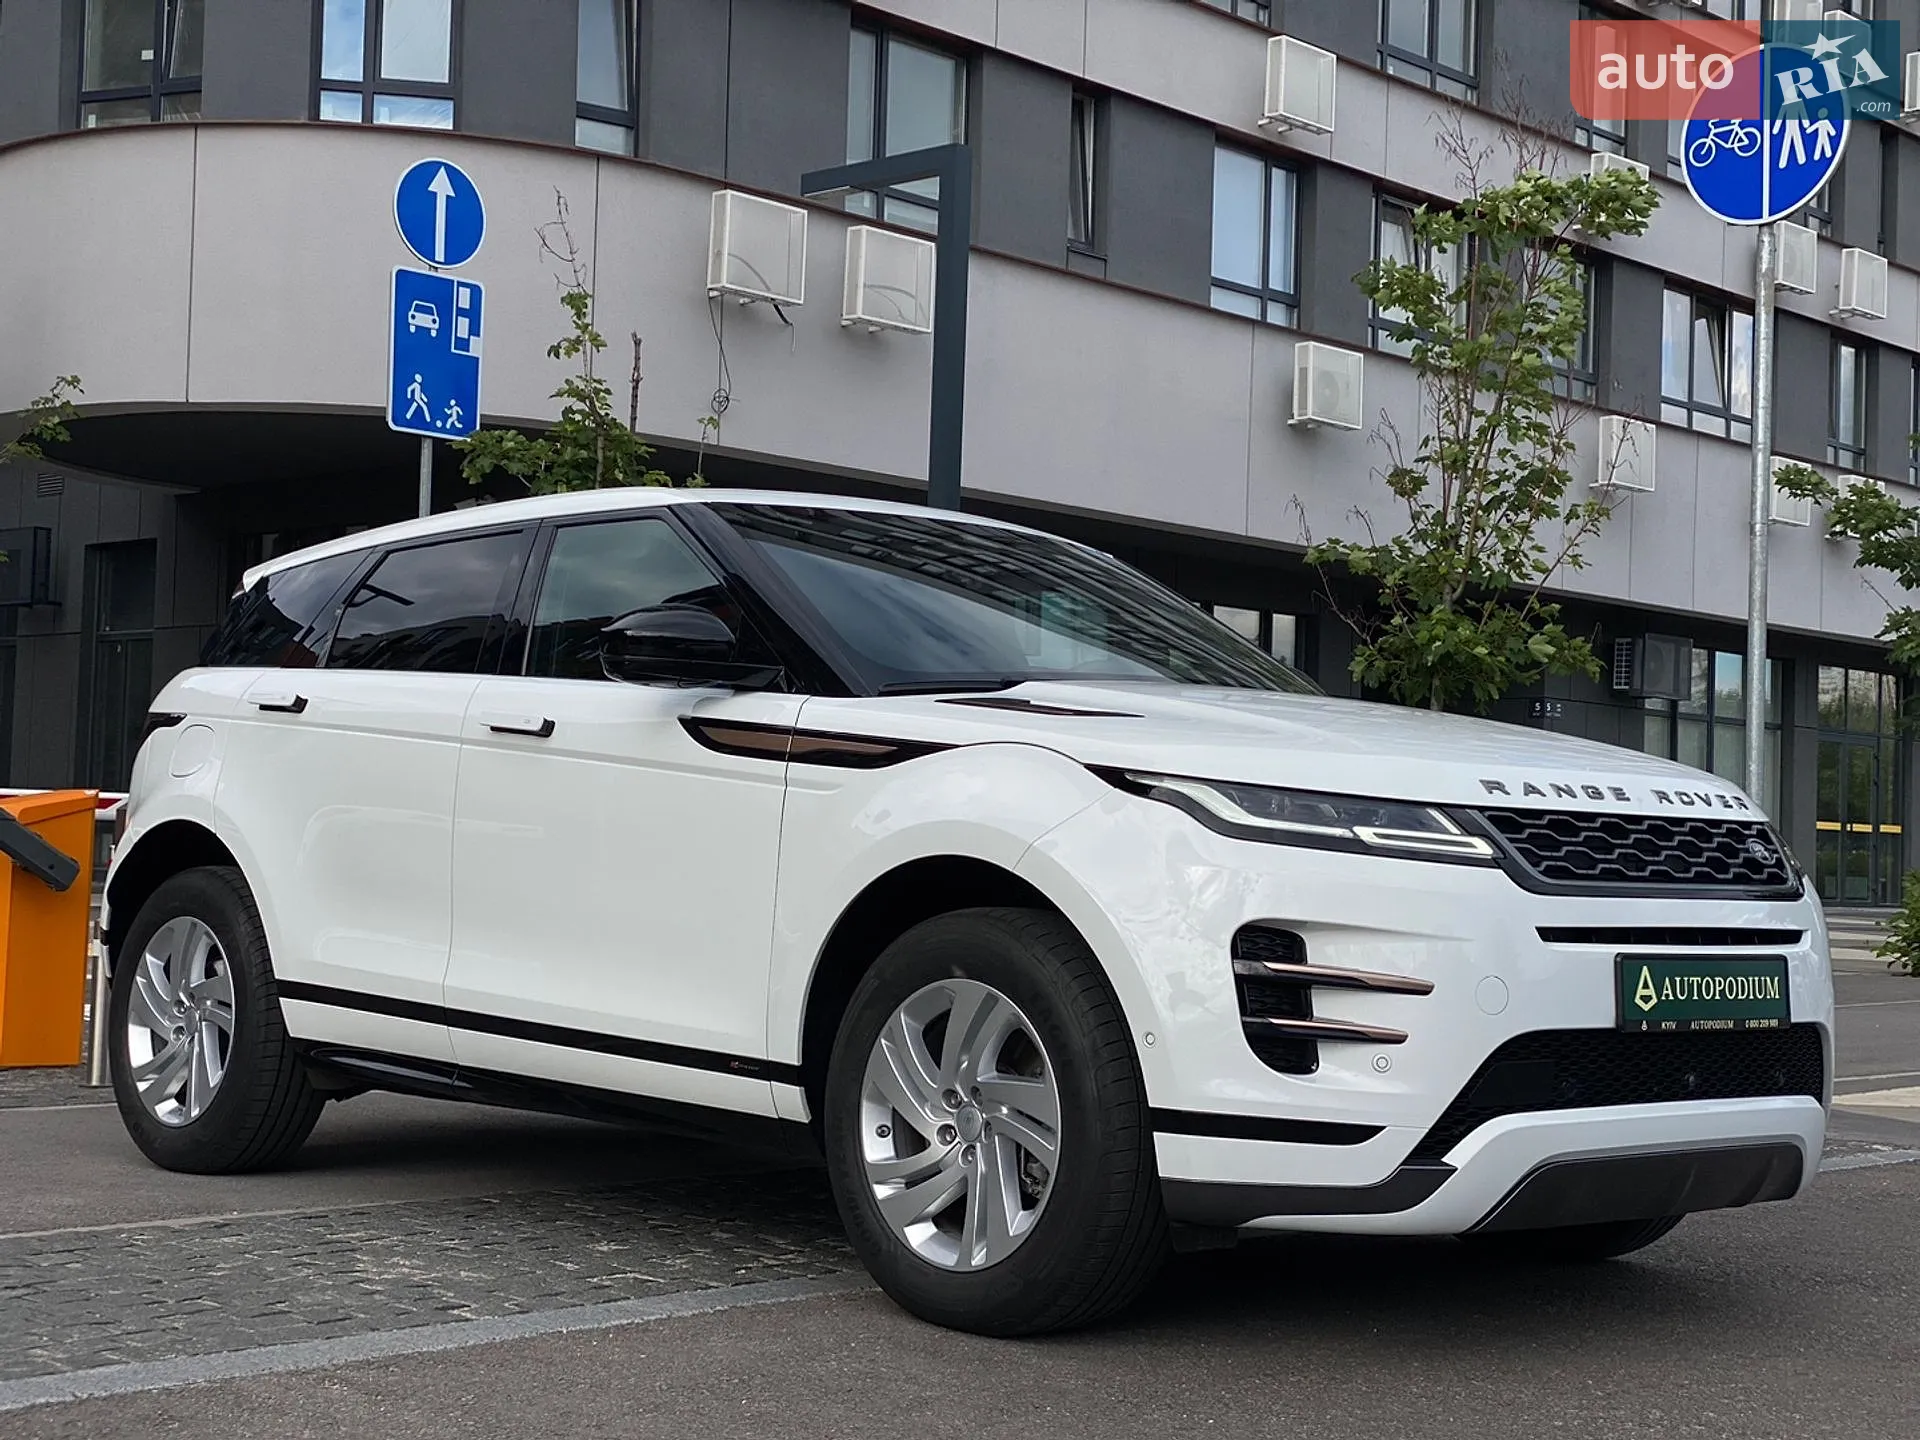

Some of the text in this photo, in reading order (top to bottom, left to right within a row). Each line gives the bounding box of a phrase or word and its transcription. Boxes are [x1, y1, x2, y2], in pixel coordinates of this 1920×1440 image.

[1479, 778, 1750, 811] RANGE ROVER
[1661, 976, 1780, 1000] AUTOPODIUM
[1690, 1020, 1735, 1030] AUTOPODIUM
